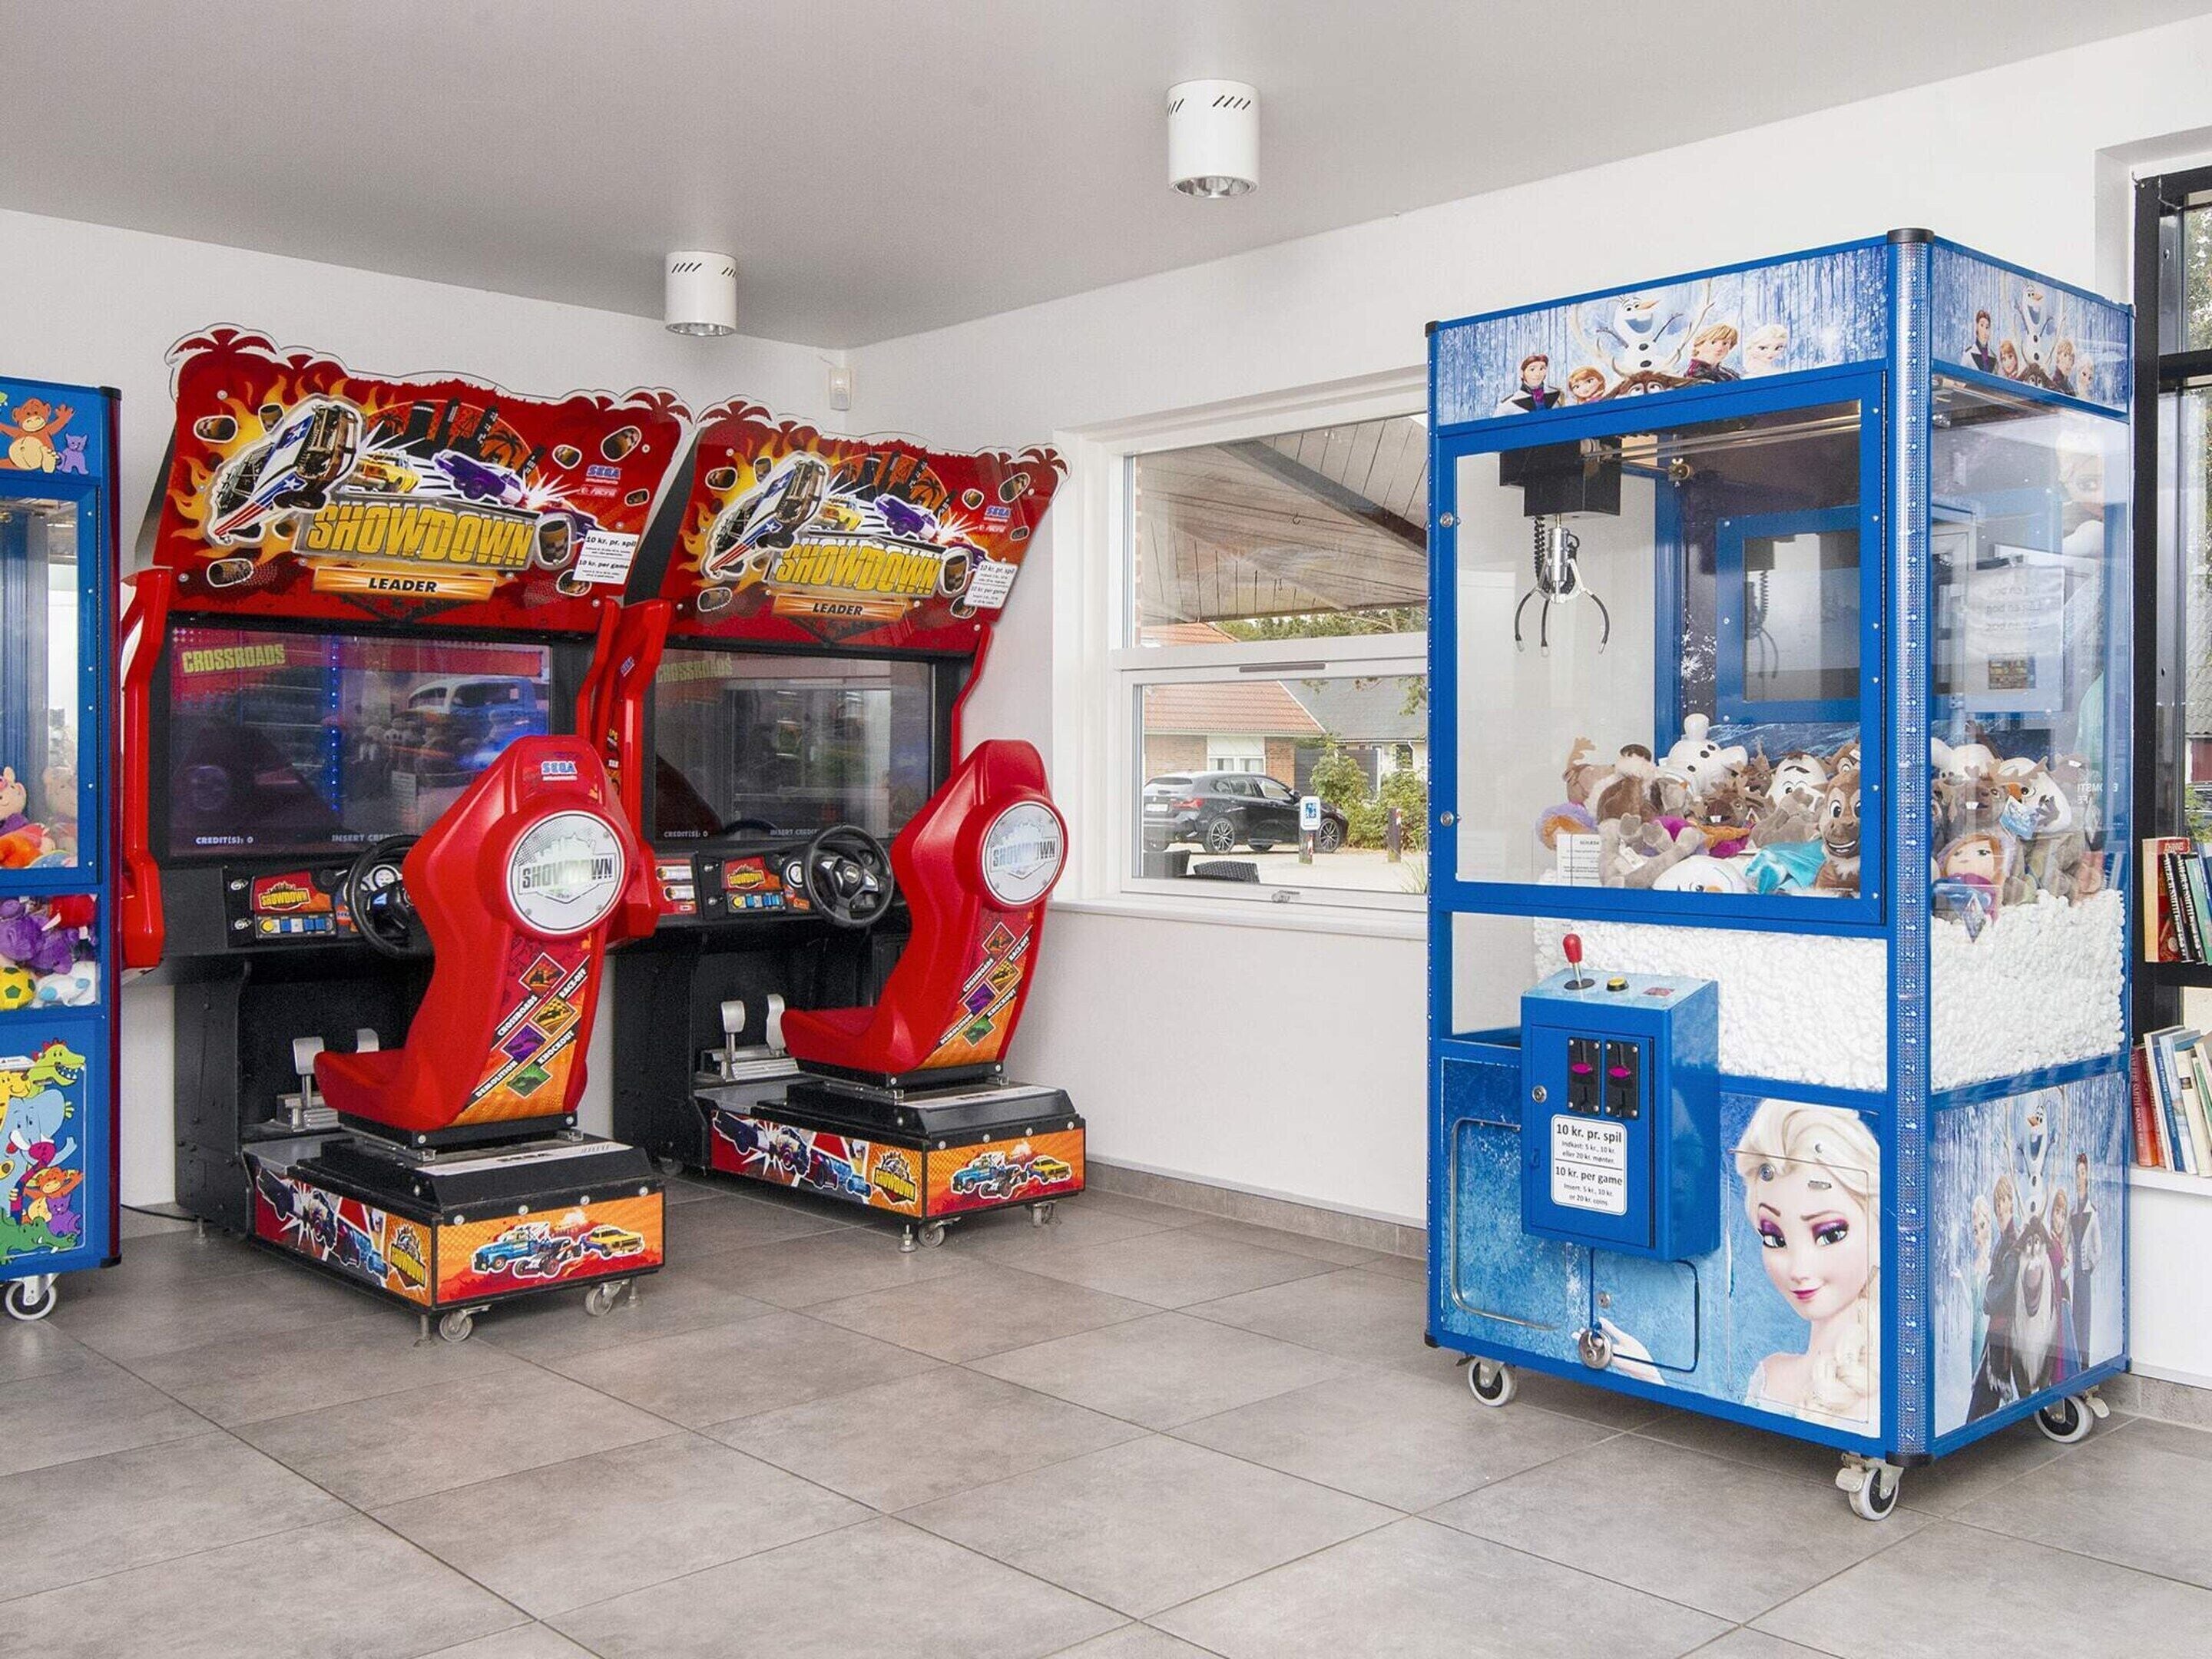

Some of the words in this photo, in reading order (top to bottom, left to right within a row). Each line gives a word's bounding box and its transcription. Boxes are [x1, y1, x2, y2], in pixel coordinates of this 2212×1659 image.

[587, 465, 621, 479] SEGA
[307, 502, 535, 566] SHOWDOWN
[776, 542, 942, 595] SHOWDOWN
[368, 577, 439, 594] LEADER
[813, 603, 864, 616] LEADER
[181, 644, 286, 674] CROSSROADS
[541, 761, 578, 774] SEGA
[261, 890, 307, 906] SHOWDOWN
[558, 968, 587, 998] RACE-OFF
[963, 958, 994, 992] CROSSROADS
[498, 995, 538, 1036] CROSSROADS
[987, 988, 1016, 1016] KNOCKOUT
[538, 1031, 575, 1064] KNOCKOUT
[475, 1061, 518, 1098] DEMOLITION
[1557, 1124, 1568, 1135] 10
[1571, 1125, 1584, 1137] kr.
[1588, 1131, 1600, 1141] pr.
[1604, 1132, 1621, 1143] spil
[1555, 1167, 1565, 1175] 10
[1568, 1168, 1578, 1178] kr.
[1581, 1172, 1595, 1181] per
[1598, 1175, 1622, 1186] game
